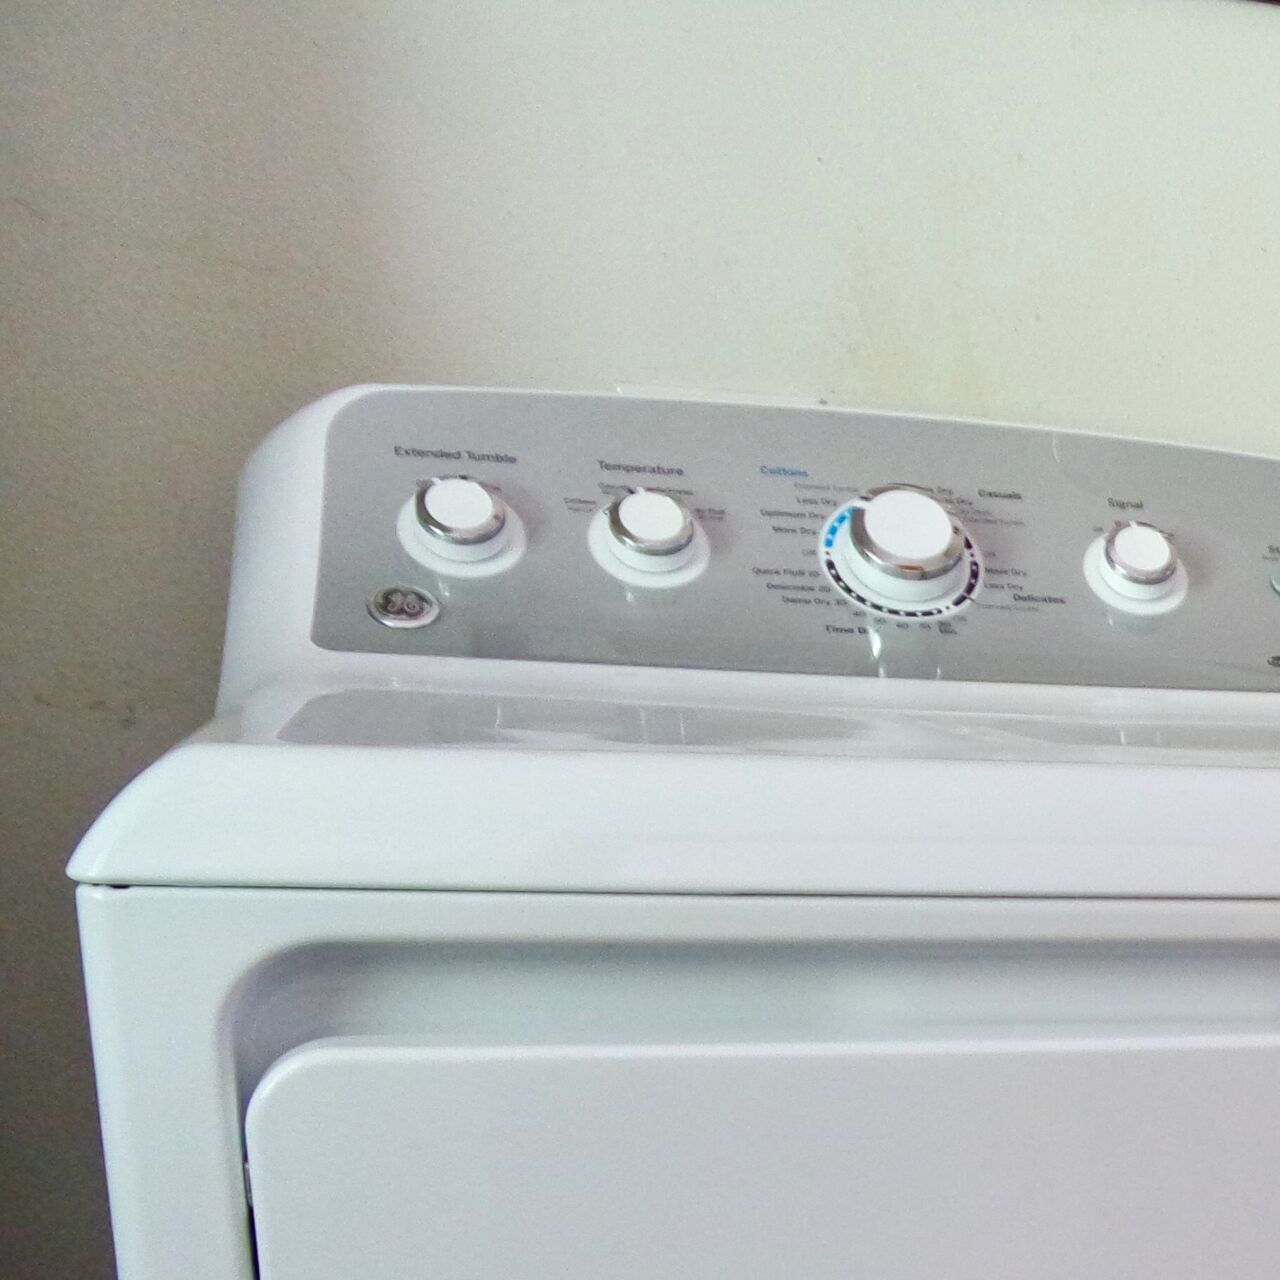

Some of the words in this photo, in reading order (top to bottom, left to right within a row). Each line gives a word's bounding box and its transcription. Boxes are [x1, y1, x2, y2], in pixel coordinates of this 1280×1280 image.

[393, 445, 462, 461] Extended
[466, 450, 518, 464] Tumble
[597, 459, 685, 477] Temperature
[978, 488, 1023, 501] Casuals
[1107, 497, 1144, 510] Signal
[1013, 592, 1067, 604] Delicates
